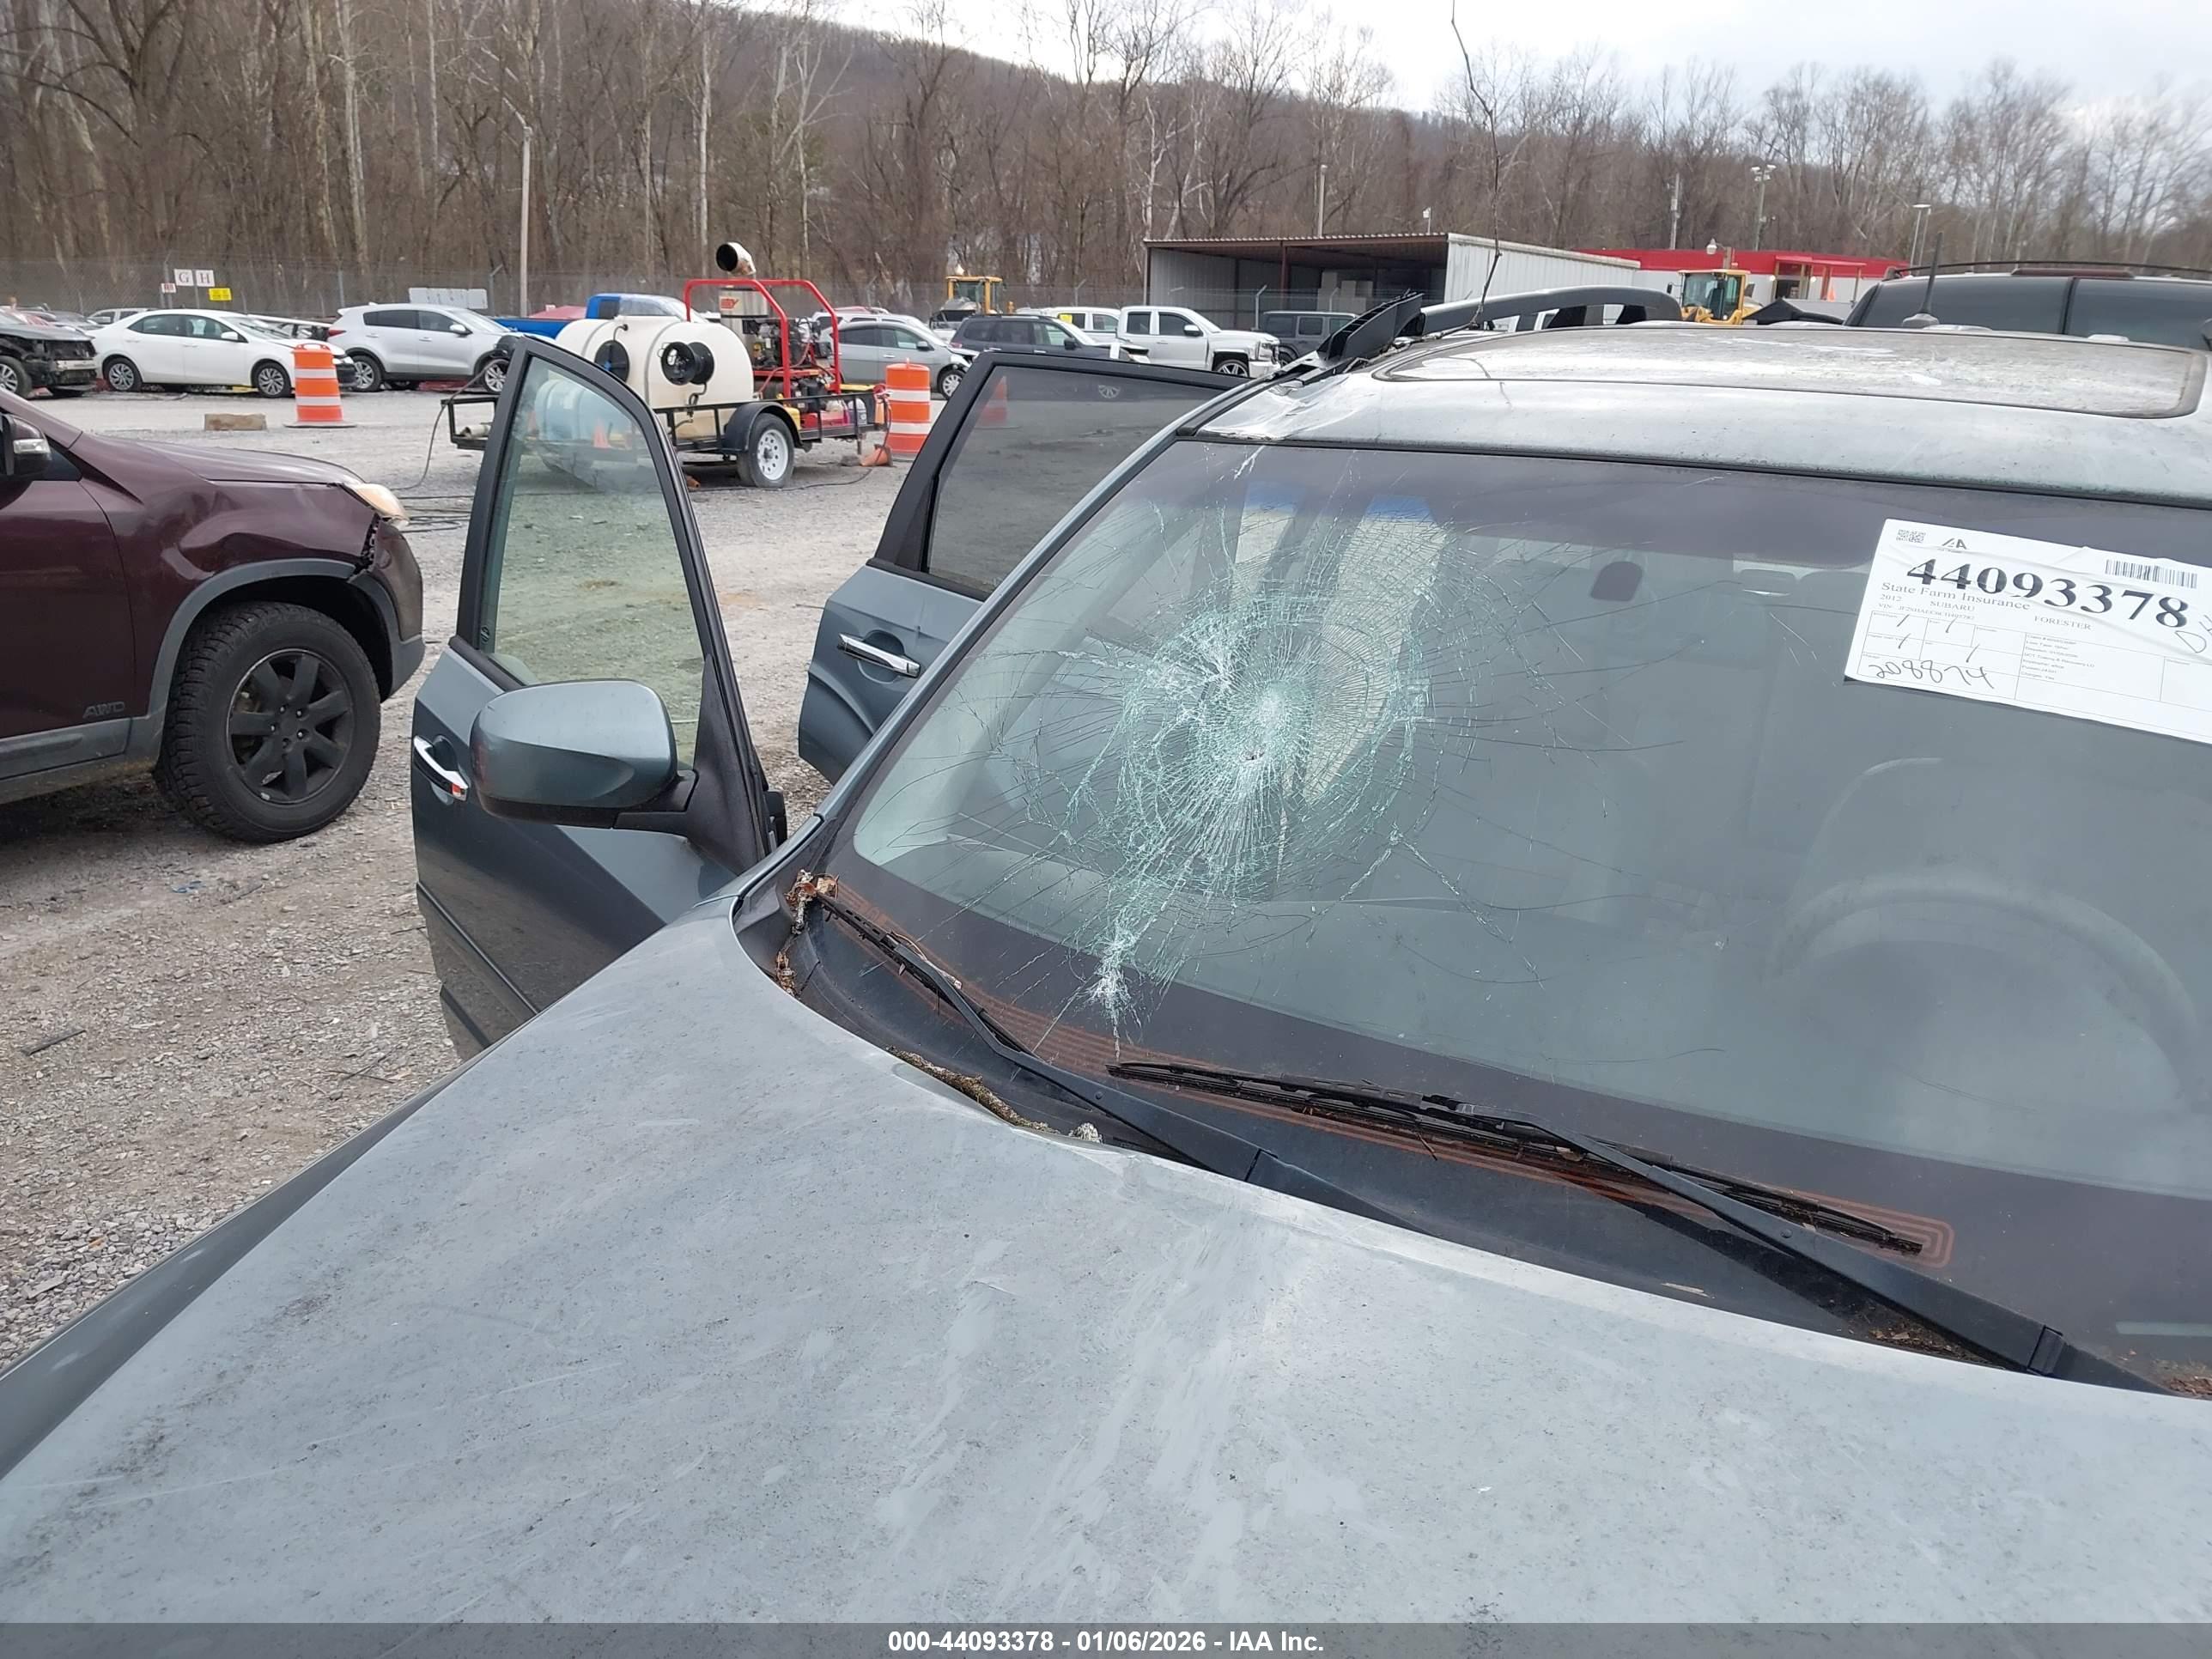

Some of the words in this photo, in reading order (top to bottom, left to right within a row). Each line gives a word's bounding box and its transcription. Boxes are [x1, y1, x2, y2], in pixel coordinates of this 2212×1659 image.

[178, 271, 190, 283] G
[198, 272, 211, 284] H
[1881, 582, 1916, 594] State
[1920, 586, 1956, 599] Farm
[1962, 592, 2031, 611] Insurance
[1906, 558, 2189, 629] 44093378
[1880, 593, 1903, 602] 2012
[1929, 600, 1975, 612] SUBARU
[2034, 616, 2092, 630] FORESTER
[1868, 659, 1995, 690] 208874
[82, 701, 125, 720] AWD
